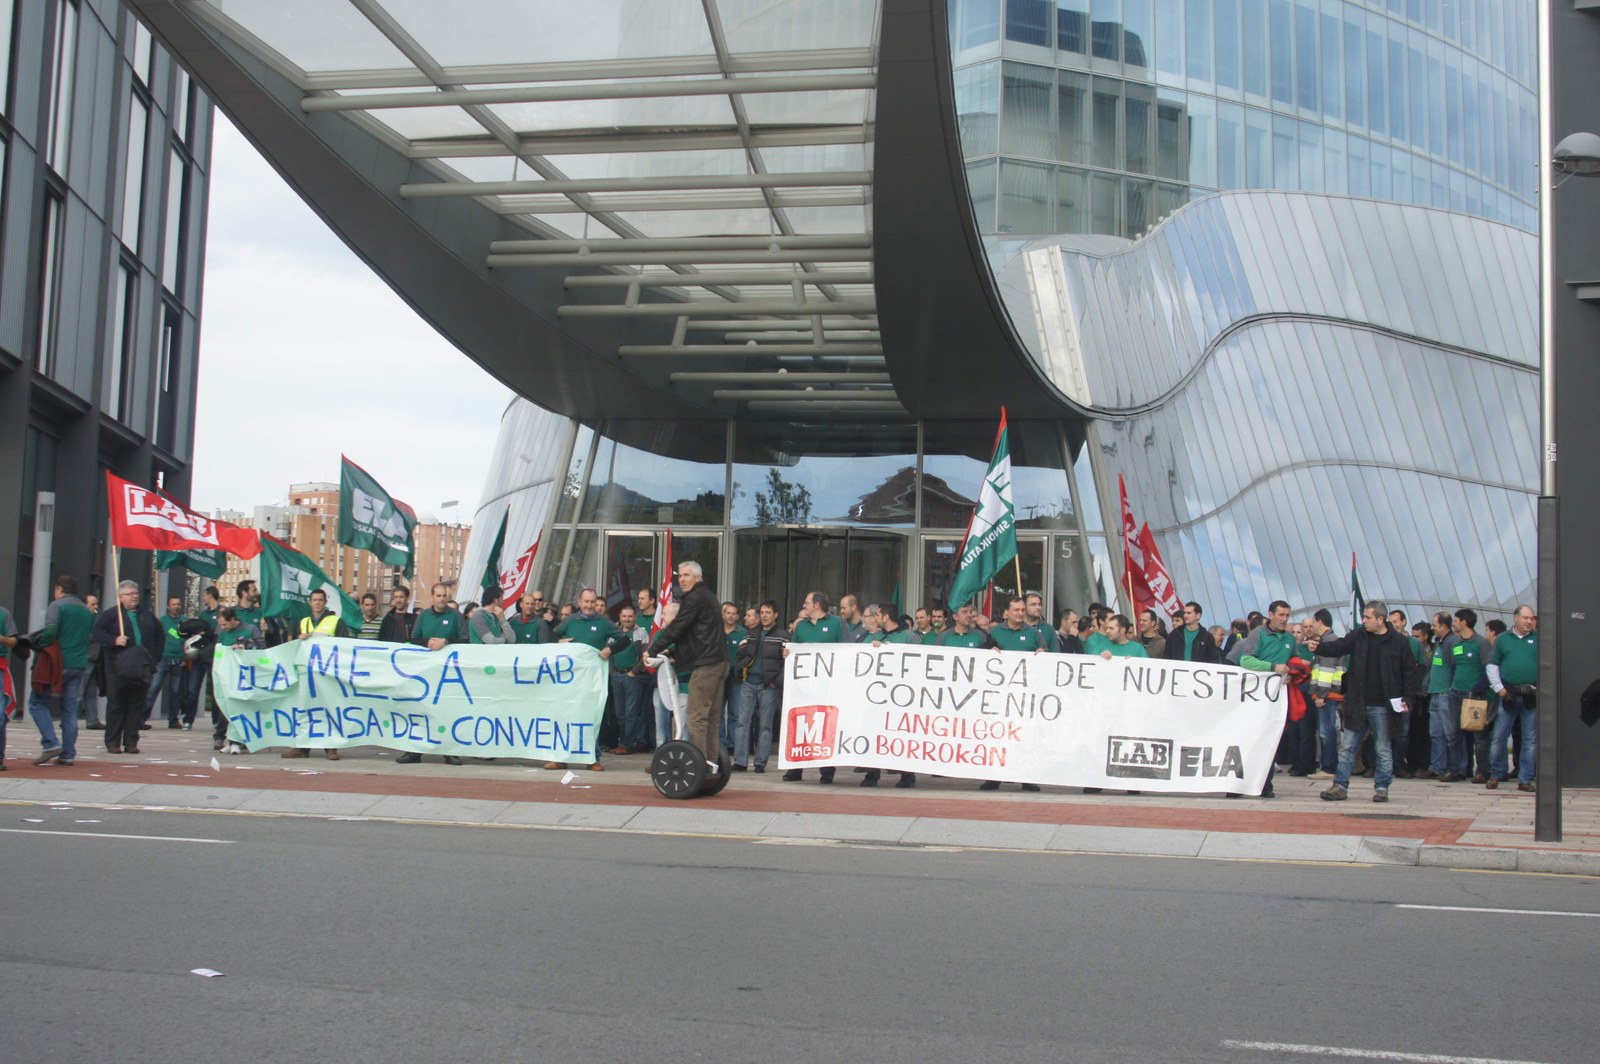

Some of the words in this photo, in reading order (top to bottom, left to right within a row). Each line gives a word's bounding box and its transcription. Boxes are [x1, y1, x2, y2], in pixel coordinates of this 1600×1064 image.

[352, 488, 408, 541] ELA
[1062, 540, 1072, 558] 5
[237, 663, 291, 692] ELA
[308, 643, 473, 705] MESA
[513, 655, 575, 686] LAB
[793, 652, 835, 679] EN
[855, 651, 1028, 688] DEFENSA
[1056, 661, 1097, 689] DE
[1123, 666, 1281, 703] NUESTRO
[866, 680, 1062, 721] CONVENIO
[390, 712, 442, 745] DEL
[796, 711, 826, 745] M
[791, 745, 832, 757] mesa
[1111, 741, 1168, 766] LAB
[1179, 745, 1245, 779] ELA
